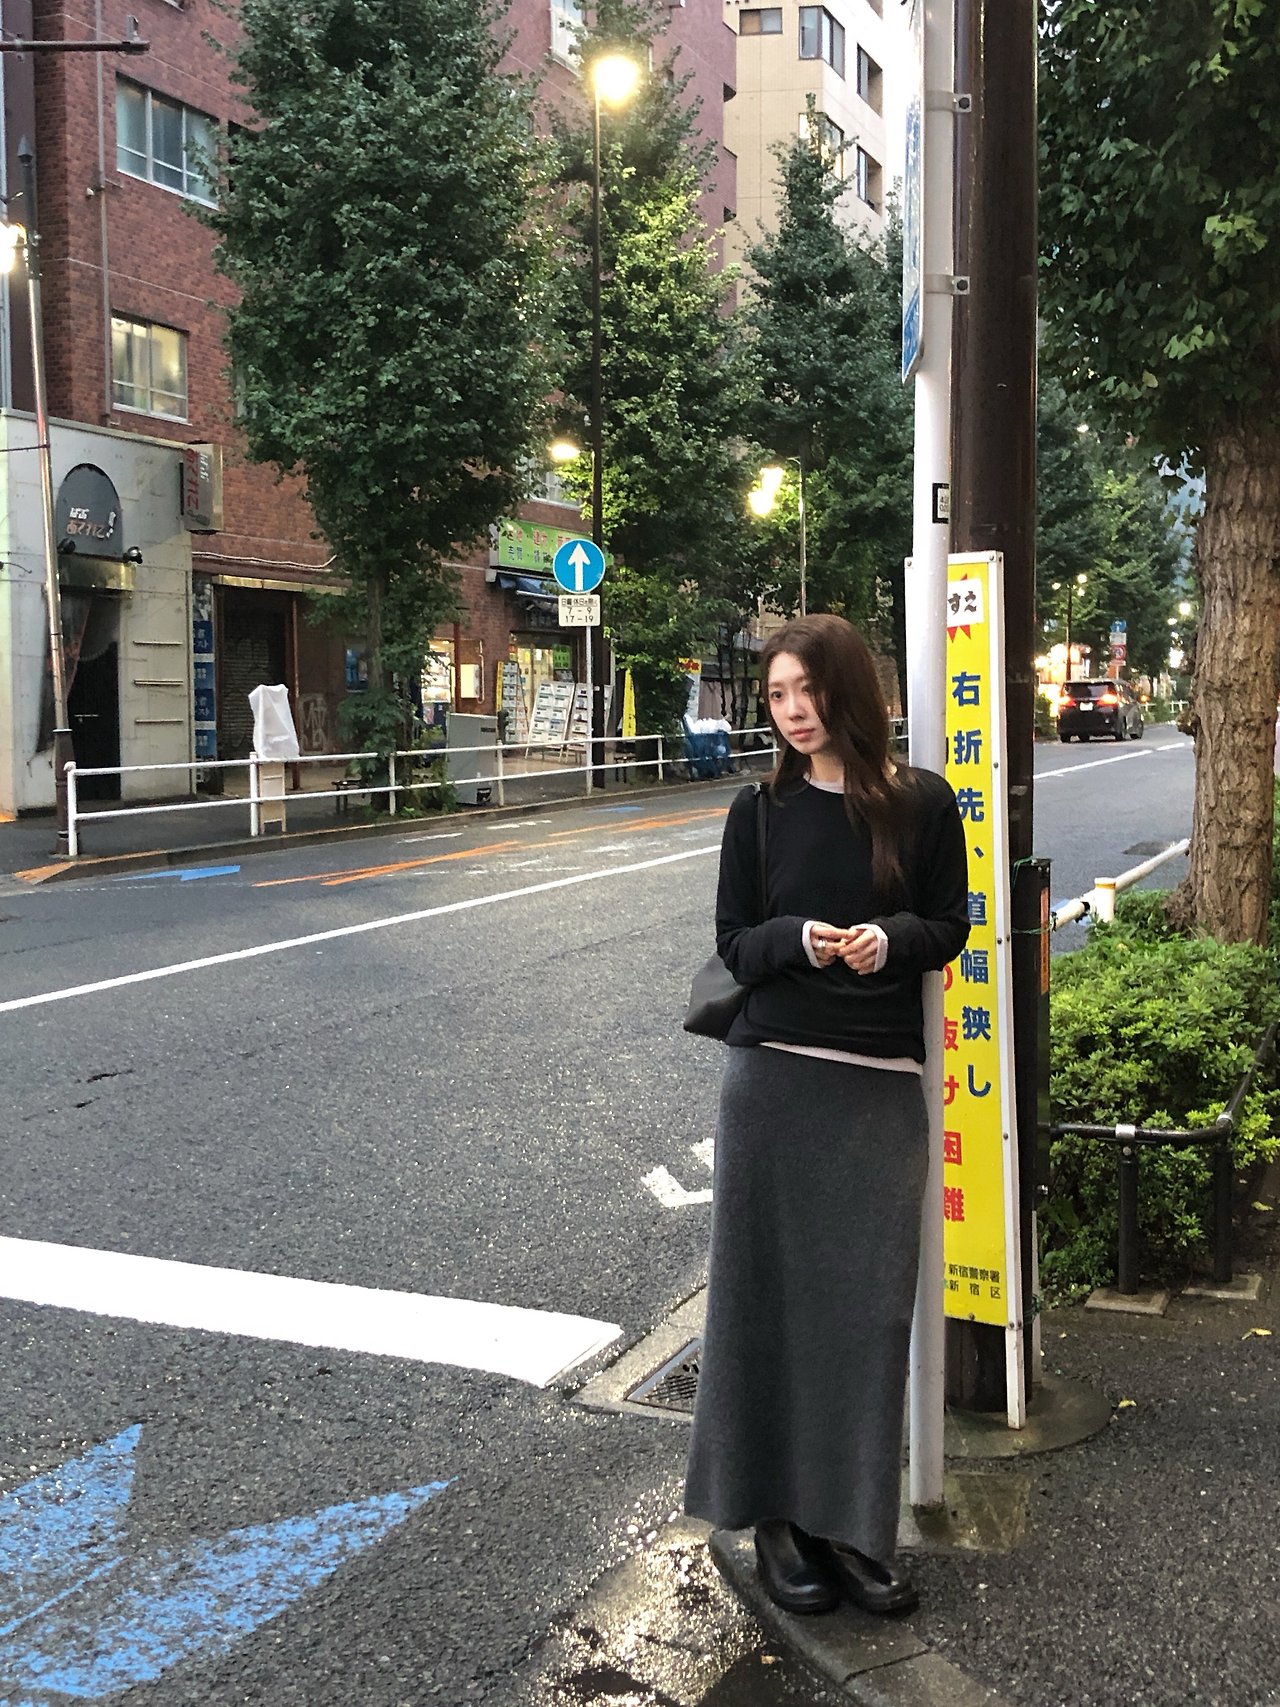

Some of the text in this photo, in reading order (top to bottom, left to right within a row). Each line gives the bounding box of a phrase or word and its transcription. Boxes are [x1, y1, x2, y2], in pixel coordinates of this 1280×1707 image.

[949, 1264, 1000, 1284] 新宿警察署
[949, 1280, 1001, 1299] 新宿区
